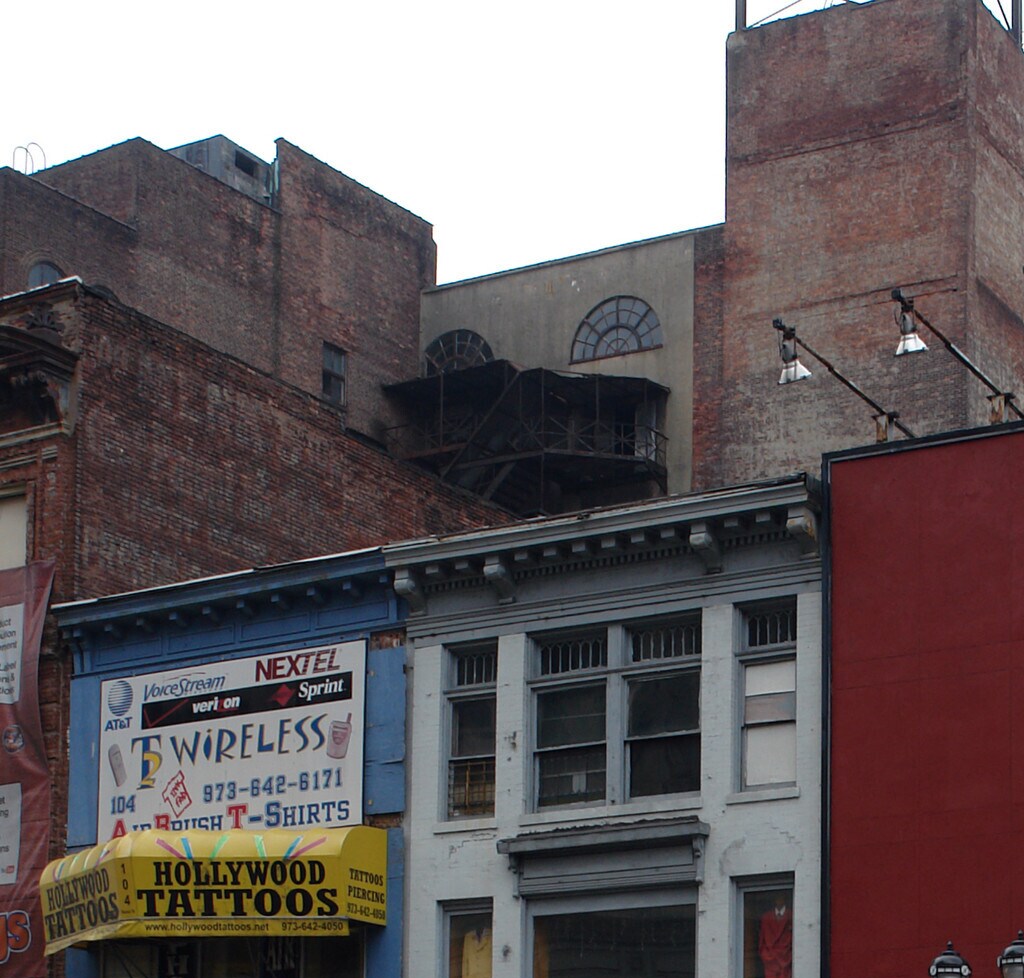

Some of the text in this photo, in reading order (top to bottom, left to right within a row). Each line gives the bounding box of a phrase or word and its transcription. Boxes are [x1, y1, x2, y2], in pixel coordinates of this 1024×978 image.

[255, 648, 340, 682] NEXTEL
[144, 676, 226, 702] VoiceStream
[298, 678, 344, 702] Sprint
[104, 717, 132, 731] AT&T
[203, 767, 343, 803] 973-642-6171
[111, 795, 136, 815] 104
[121, 863, 131, 906] 104
[153, 861, 326, 886] HOLLYWOOD
[349, 867, 384, 887] TATTOOS
[46, 868, 110, 912] HOLLYWOOD
[136, 888, 339, 917] TATTOOS
[348, 885, 385, 905] PIERCING
[44, 892, 120, 940] TATTOOS
[145, 921, 344, 933] www.hollywoodtattoos.net 973-642-4050
